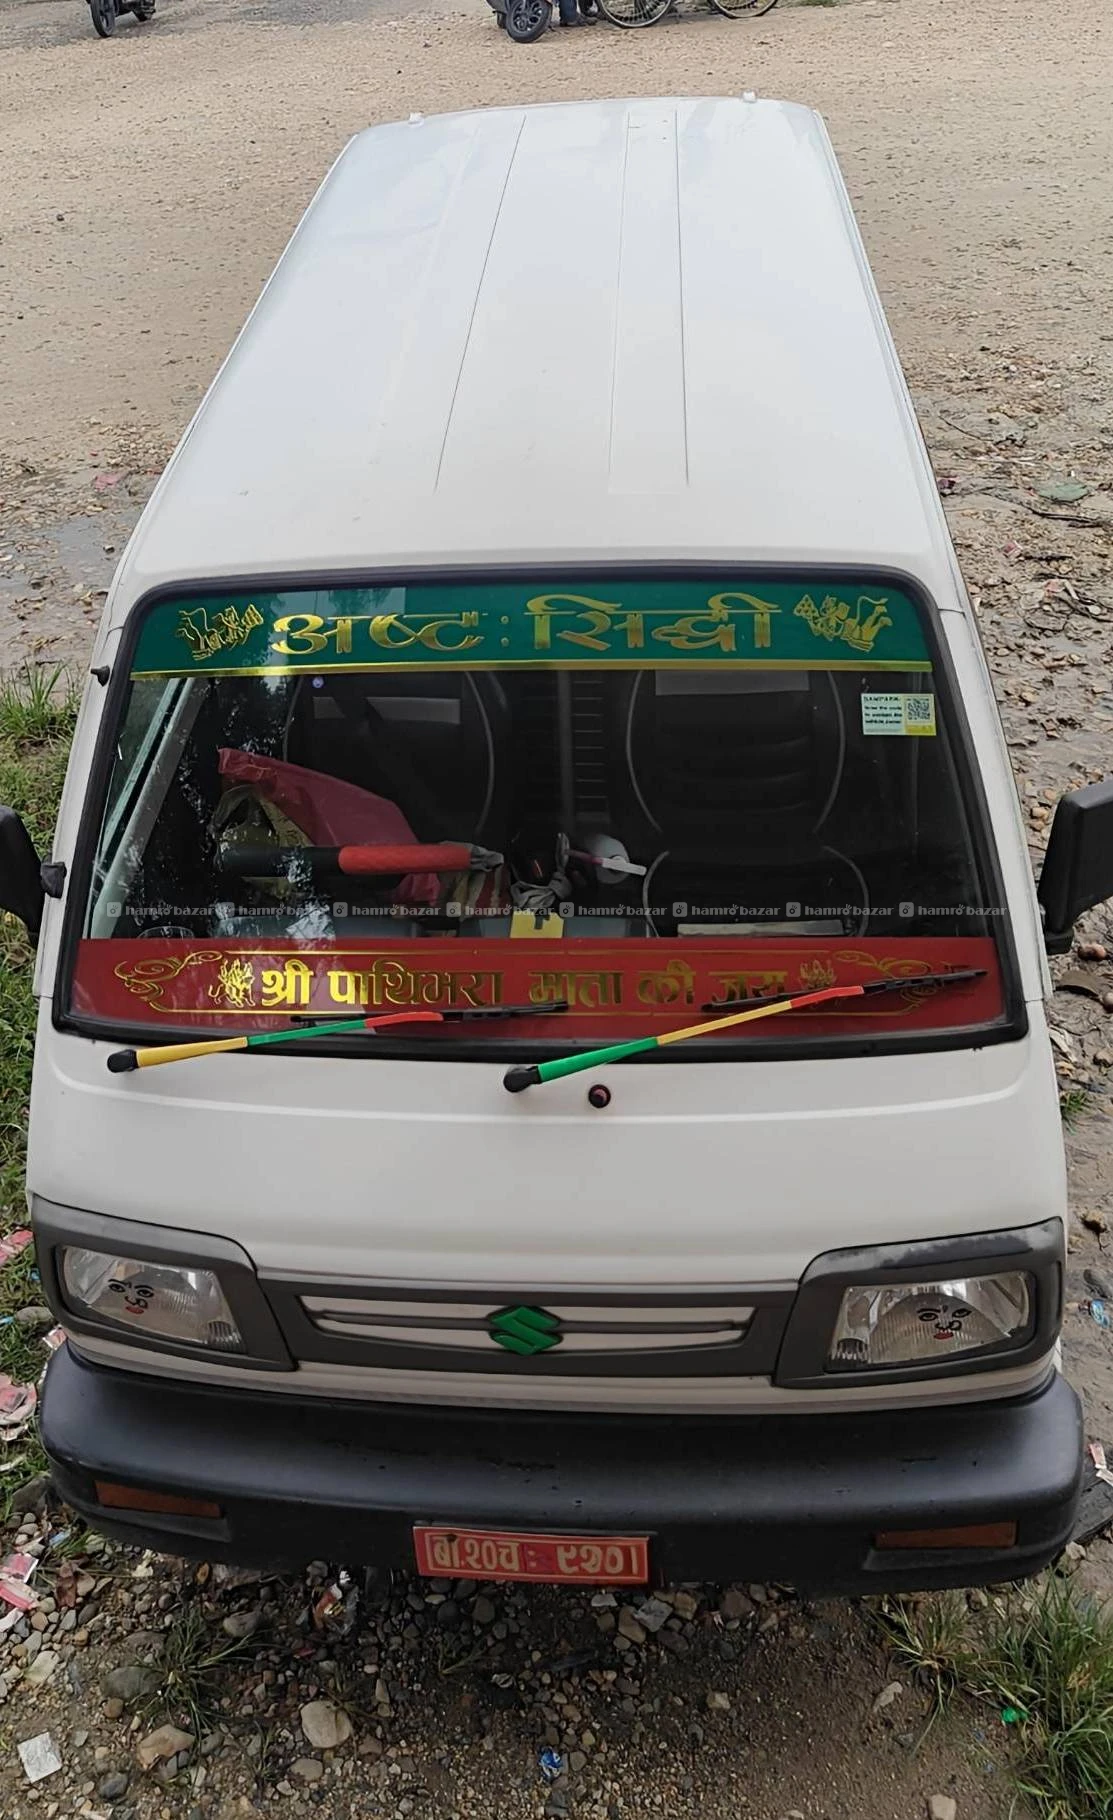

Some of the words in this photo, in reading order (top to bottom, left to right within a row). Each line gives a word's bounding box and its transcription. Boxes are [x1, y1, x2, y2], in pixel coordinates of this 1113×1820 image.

[261, 959, 314, 1006] श्री
[528, 970, 624, 1007] माता
[636, 959, 697, 1005] की
